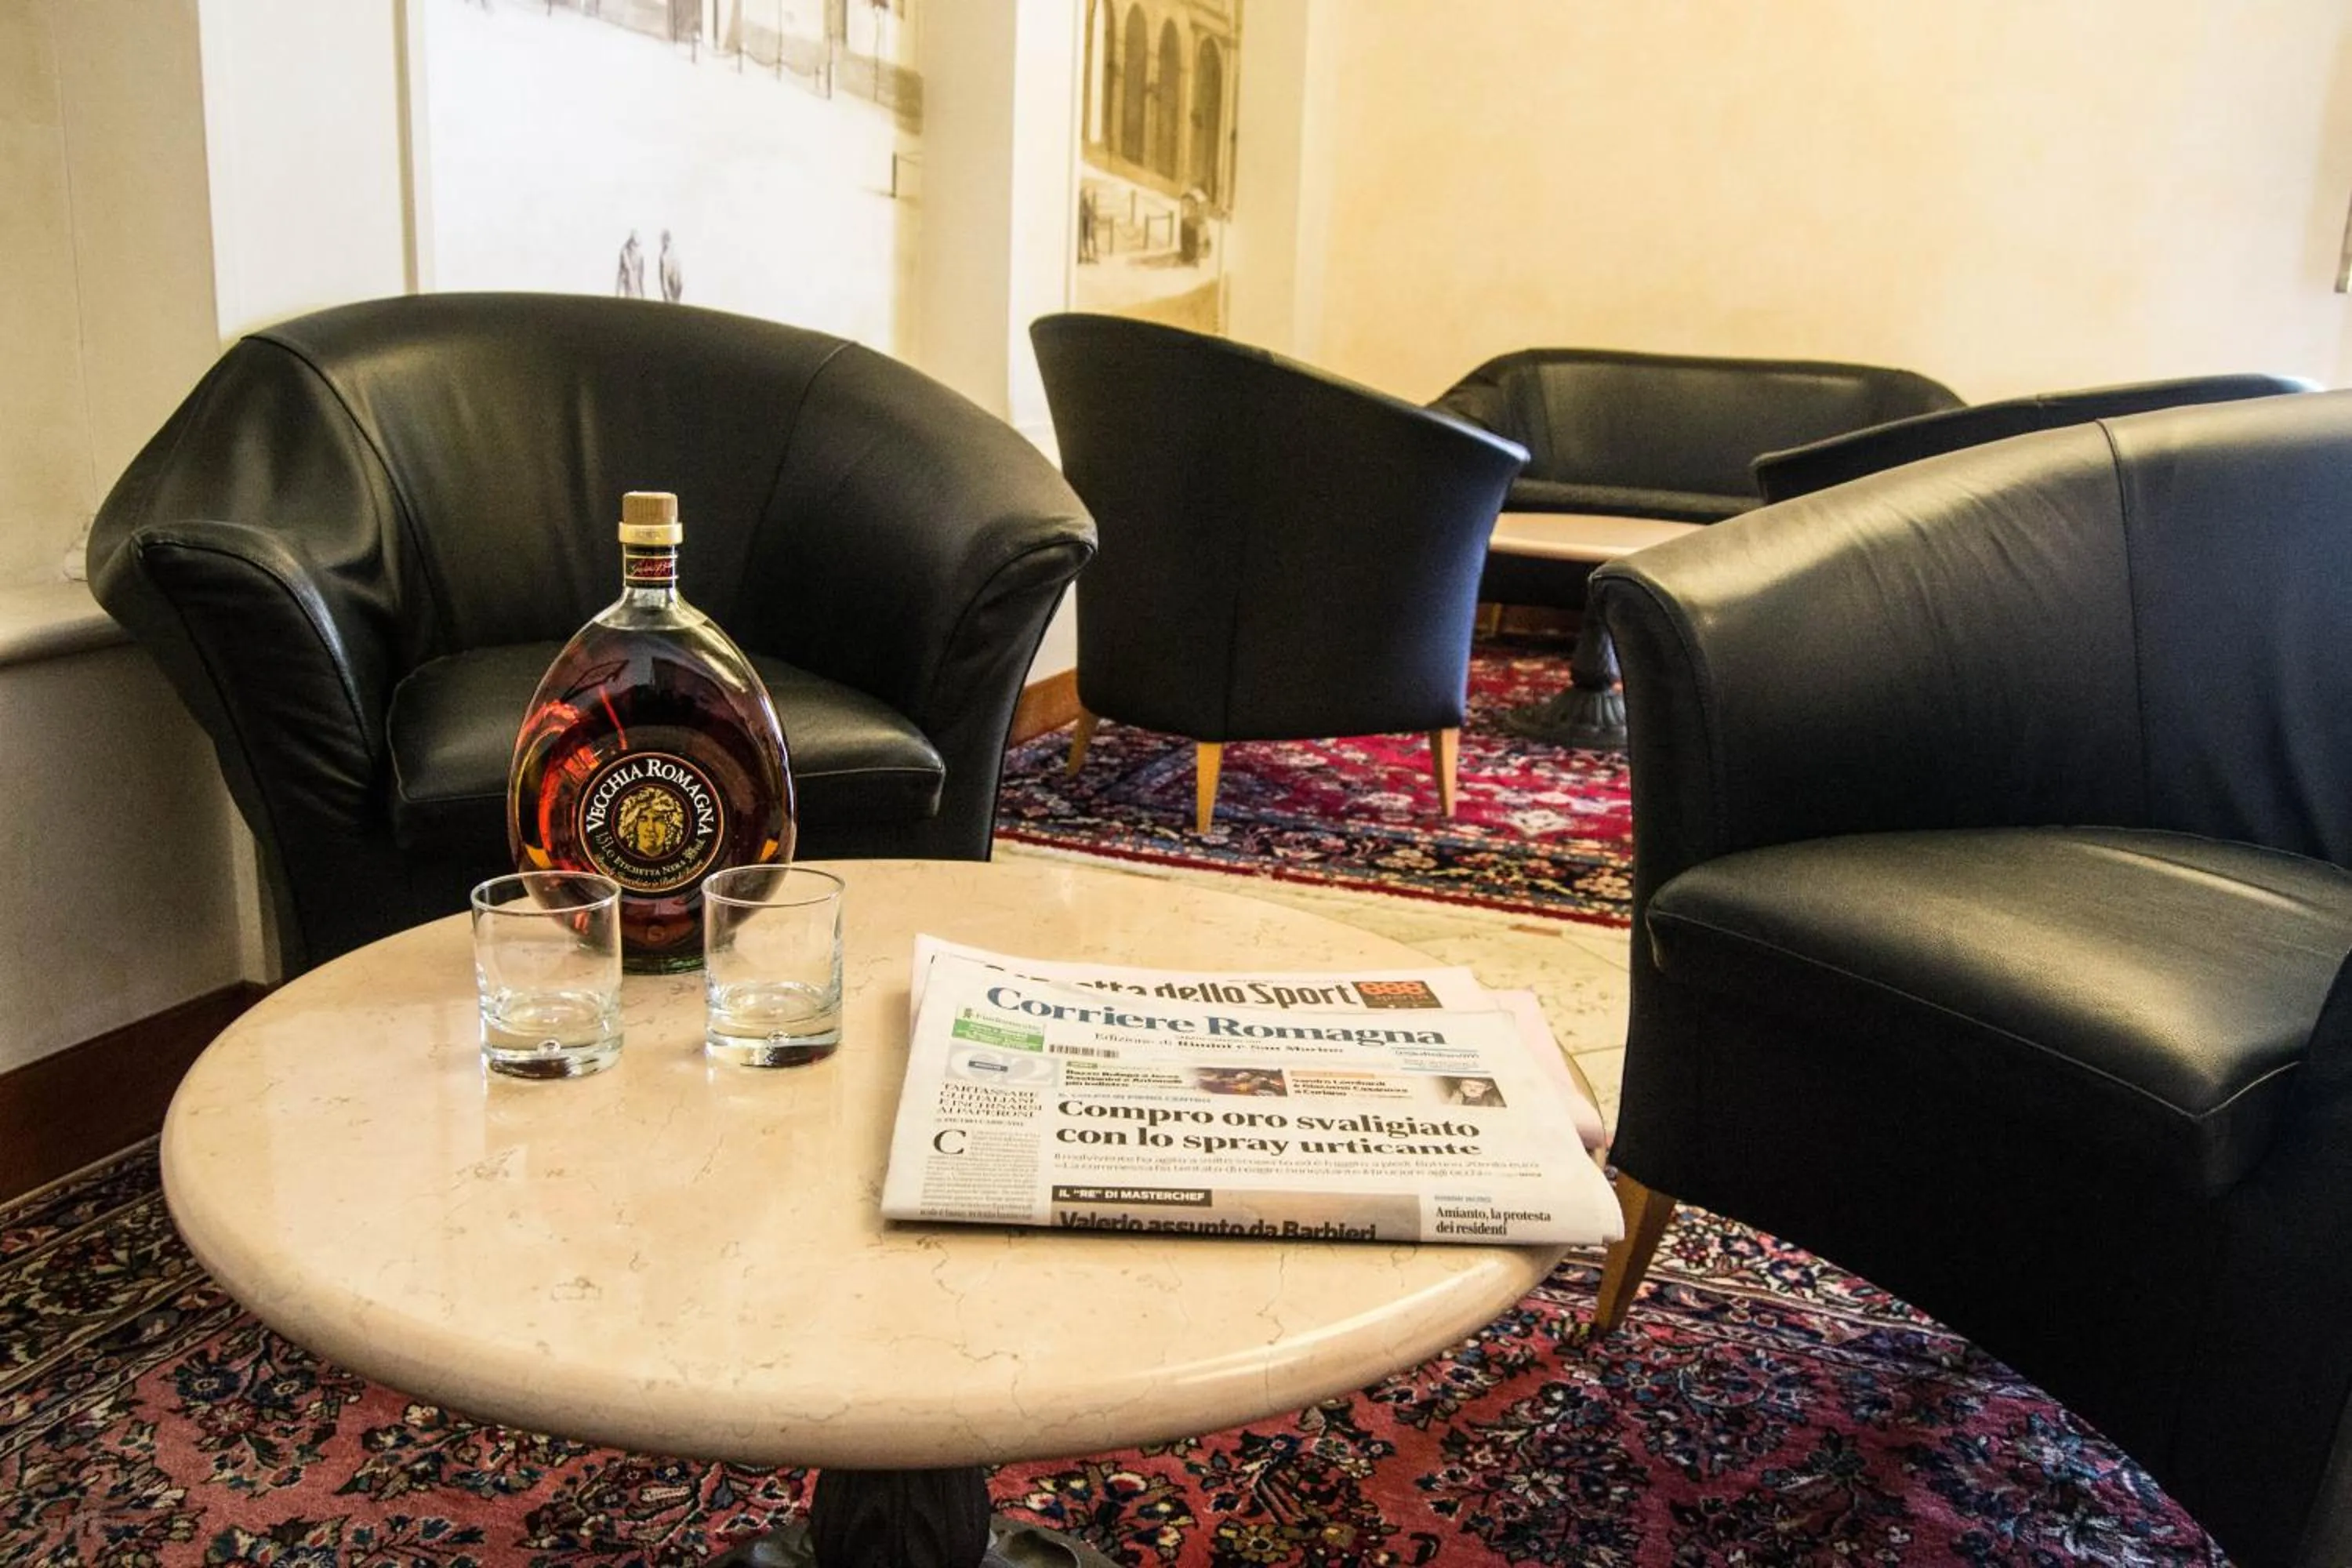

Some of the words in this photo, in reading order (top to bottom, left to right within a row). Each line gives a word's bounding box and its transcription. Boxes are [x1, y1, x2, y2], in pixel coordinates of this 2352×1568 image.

[586, 763, 644, 833] VECCHIA
[644, 758, 714, 835] ROMAGNA
[612, 855, 661, 877] ETICHETTA
[662, 860, 687, 873] NERA
[1247, 982, 1359, 1009] Sport
[987, 986, 1196, 1033] Corriere
[1205, 1015, 1447, 1047] Romagna
[1058, 1100, 1214, 1127] Compro
[1222, 1111, 1288, 1128] oro
[1296, 1114, 1481, 1138] svaligiato
[933, 1128, 967, 1156] C
[1056, 1127, 1127, 1145] con
[1138, 1127, 1174, 1148] lo
[1182, 1134, 1290, 1156] spray
[1301, 1138, 1482, 1156] urticante
[1058, 1189, 1070, 1199] IL
[1105, 1190, 1119, 1200] DI
[1120, 1190, 1206, 1201] MASTERCHEF
[1059, 1210, 1143, 1232] Valerio
[1249, 1218, 1277, 1238] da
[1281, 1220, 1377, 1241] Barbieri
[1436, 1206, 1490, 1221] Amianto,
[1490, 1208, 1502, 1221] la
[1503, 1210, 1552, 1225] protesta
[1436, 1221, 1454, 1234] dei
[1456, 1221, 1508, 1236] residenti
